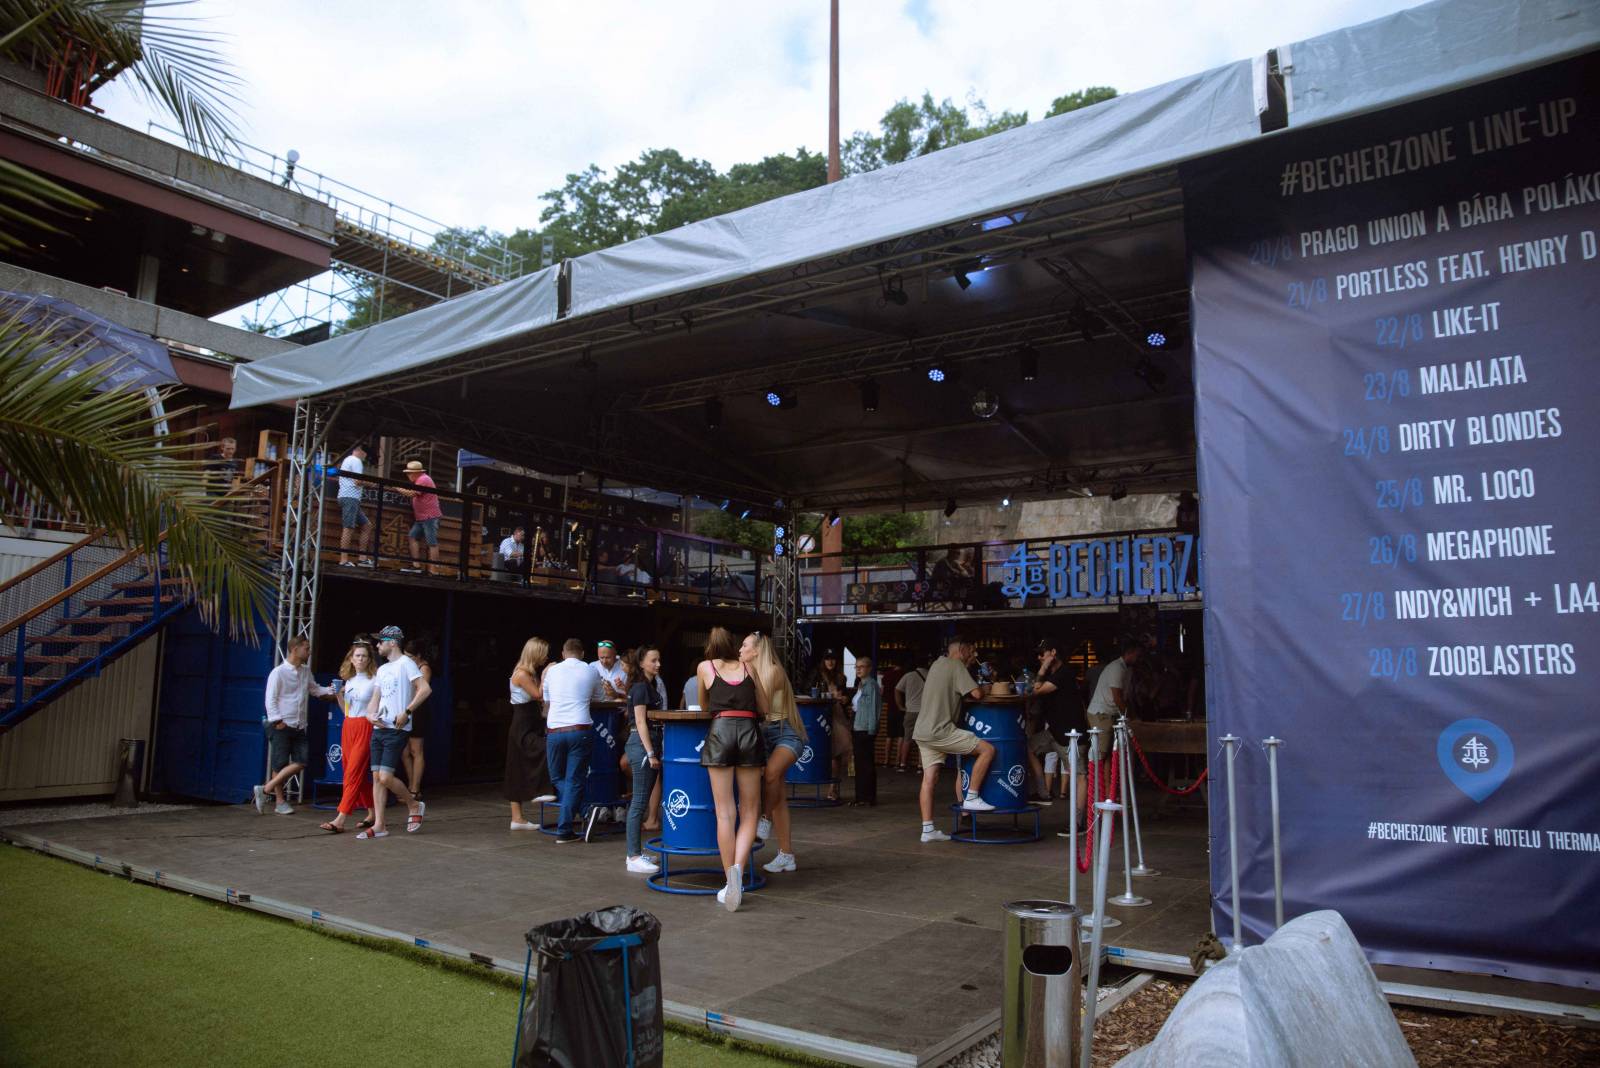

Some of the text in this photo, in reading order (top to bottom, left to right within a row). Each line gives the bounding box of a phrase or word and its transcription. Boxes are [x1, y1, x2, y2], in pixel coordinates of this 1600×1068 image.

[1280, 97, 1577, 196] #BECHERZONE LINE-UP
[1301, 224, 1359, 257] PRAGO
[1368, 210, 1427, 246] UNION
[1436, 205, 1450, 233] A
[1459, 192, 1514, 228] BÁRA
[1287, 230, 1597, 310] 21/8 PORTLESS FEAT. HENRY D
[1375, 302, 1500, 348] 22/8 LIKE-IT
[1364, 355, 1528, 403] 23/8 MALALATA
[1343, 408, 1562, 460] 24/8 DIRTY BLONDES
[1376, 468, 1536, 512] 25/8 MR. LOCO
[1049, 534, 1200, 600] BECHERZ
[1369, 525, 1556, 568] 26/8 MEGAPHONE
[1341, 591, 1387, 628] 27/8
[1395, 586, 1513, 620] INDY&WICH
[1369, 643, 1577, 683] 28/8 ZOOBLASTERS
[1367, 822, 1448, 843] #BECHERZONE
[1452, 827, 1489, 846] VEDLE
[1494, 829, 1541, 849] HOTELU
